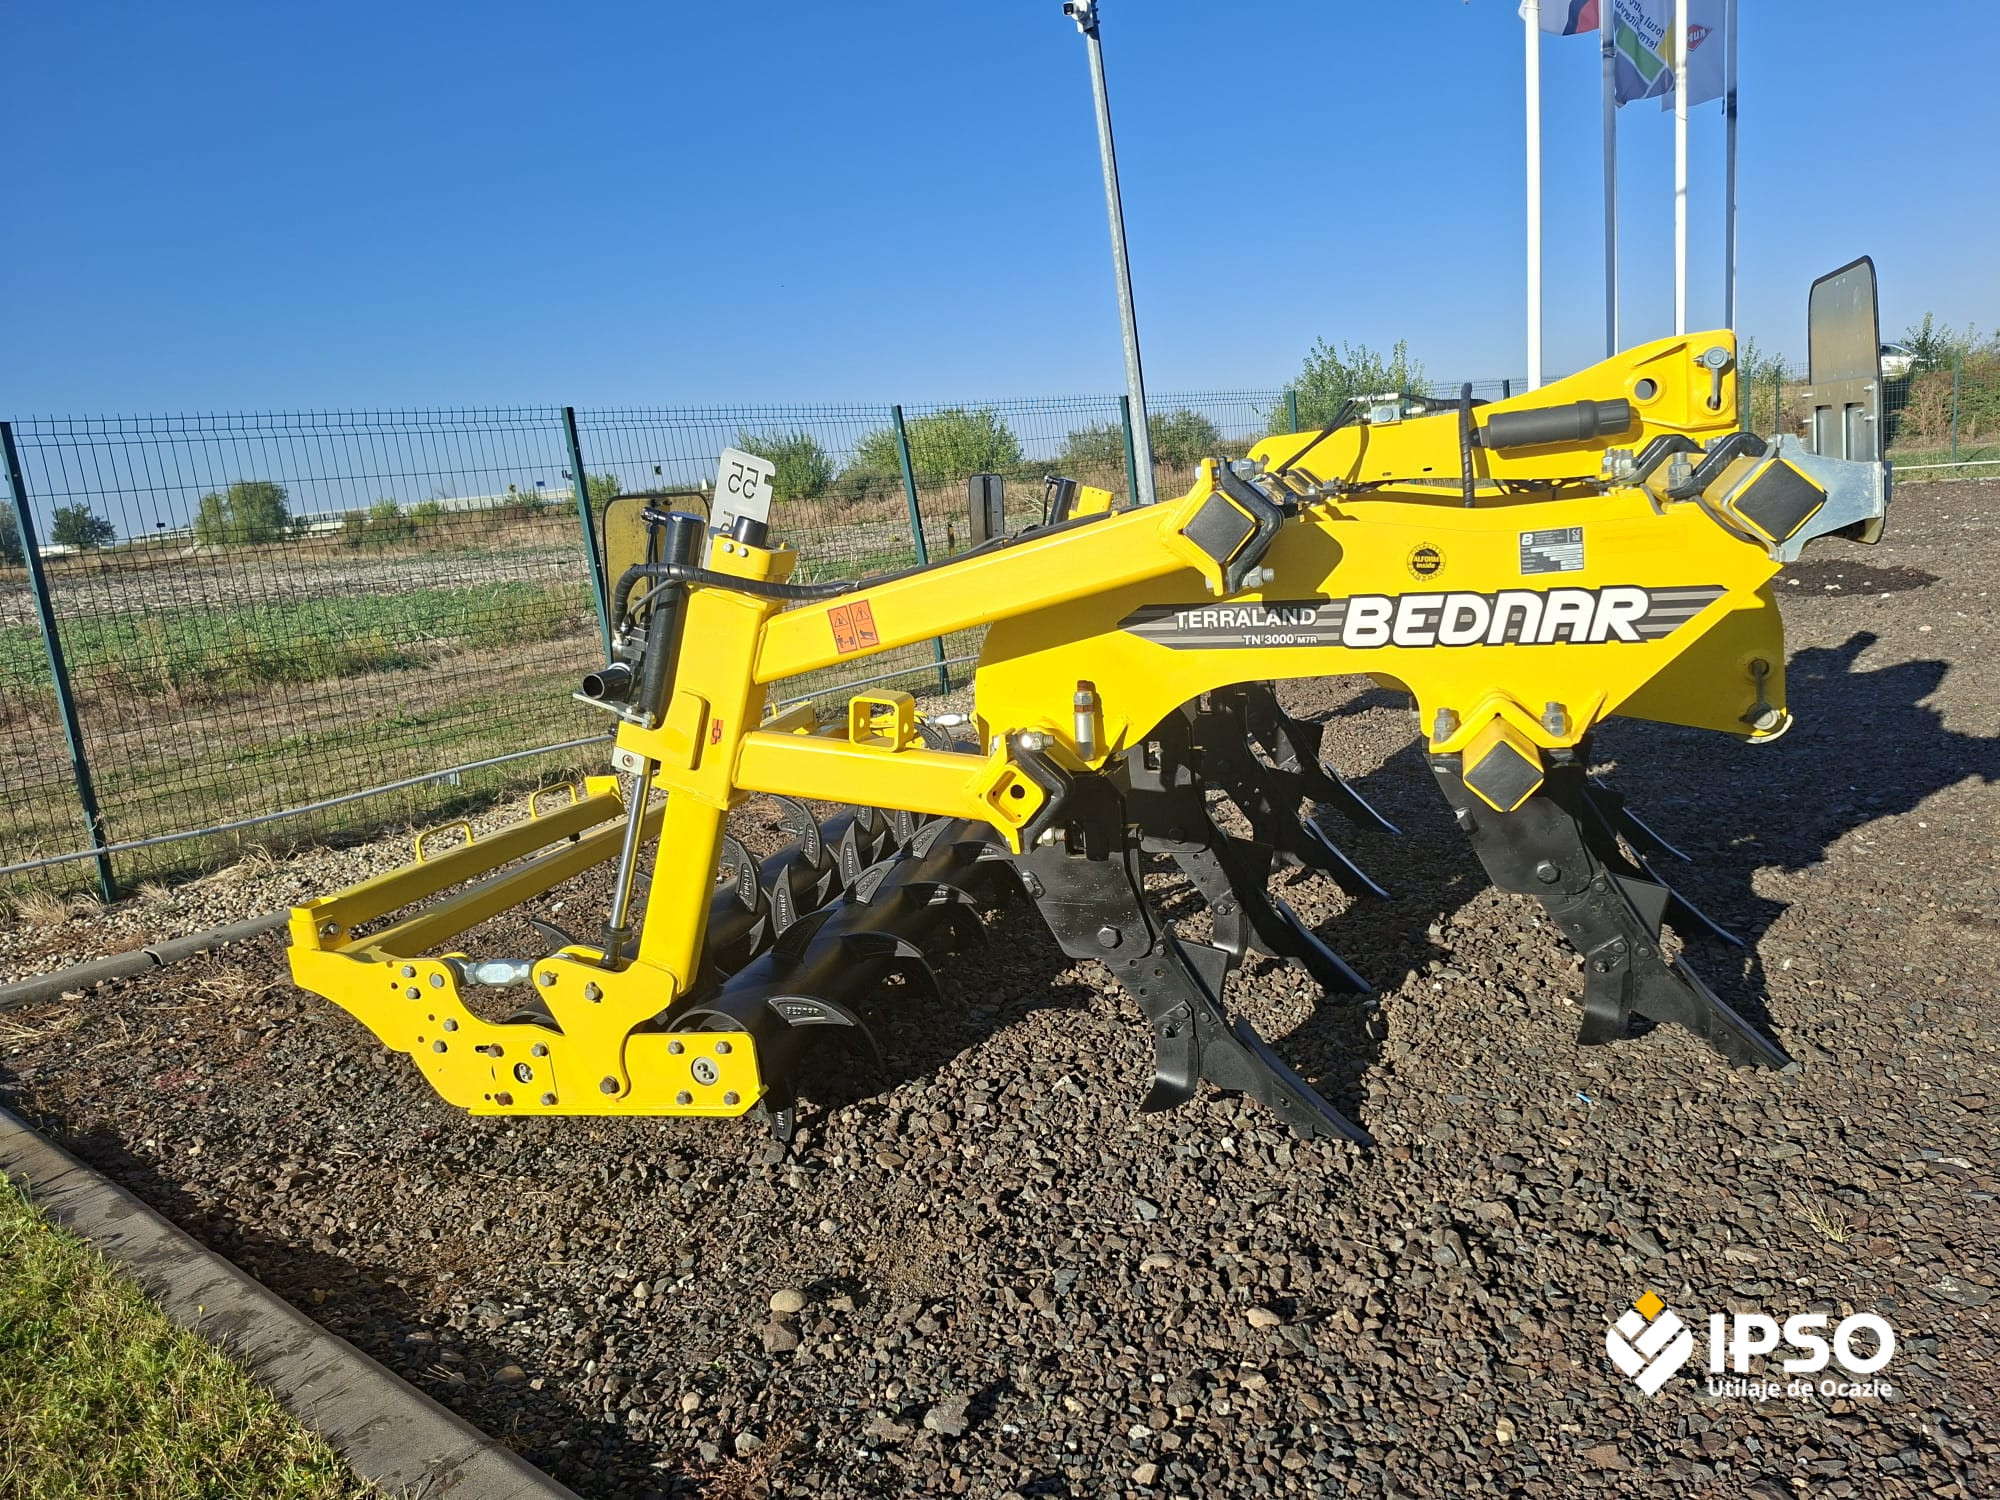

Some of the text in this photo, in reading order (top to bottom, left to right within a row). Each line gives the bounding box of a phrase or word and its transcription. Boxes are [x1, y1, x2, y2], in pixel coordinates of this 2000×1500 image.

[1522, 533, 1534, 546] B
[1413, 555, 1440, 563] ALFORM
[1175, 607, 1317, 629] TERRALAND
[1342, 587, 1649, 647] BEDNAR
[1242, 634, 1318, 645] TN 3000 M7R
